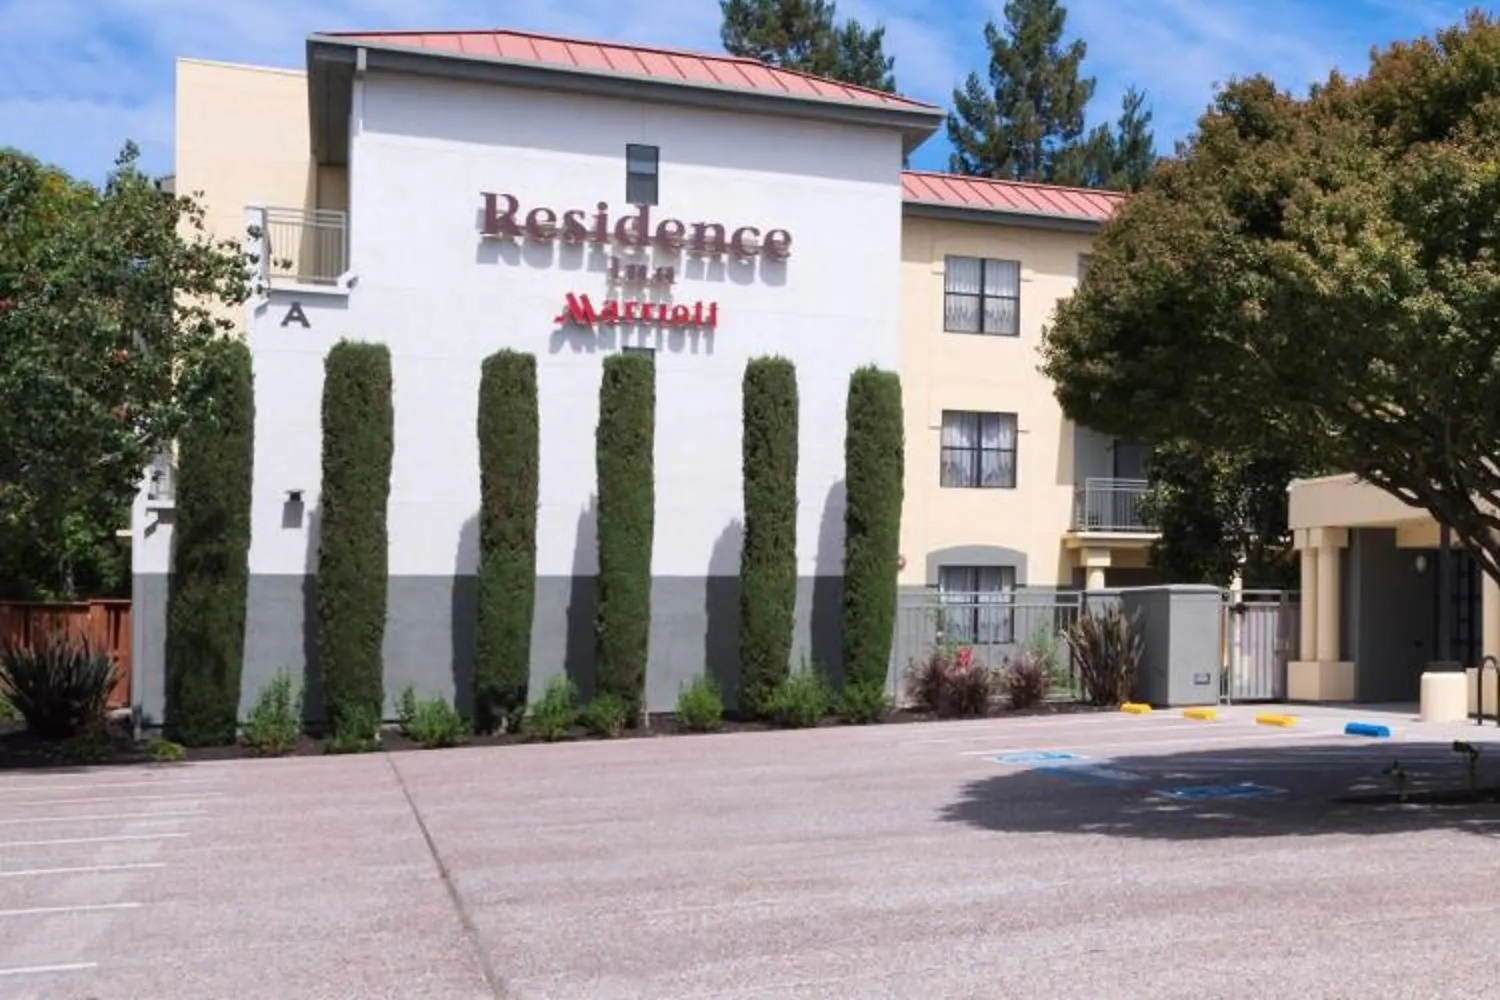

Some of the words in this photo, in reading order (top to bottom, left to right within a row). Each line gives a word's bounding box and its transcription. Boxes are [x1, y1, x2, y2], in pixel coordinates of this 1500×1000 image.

[480, 192, 793, 257] Residence
[280, 301, 311, 328] A
[553, 292, 718, 328] Marriott
